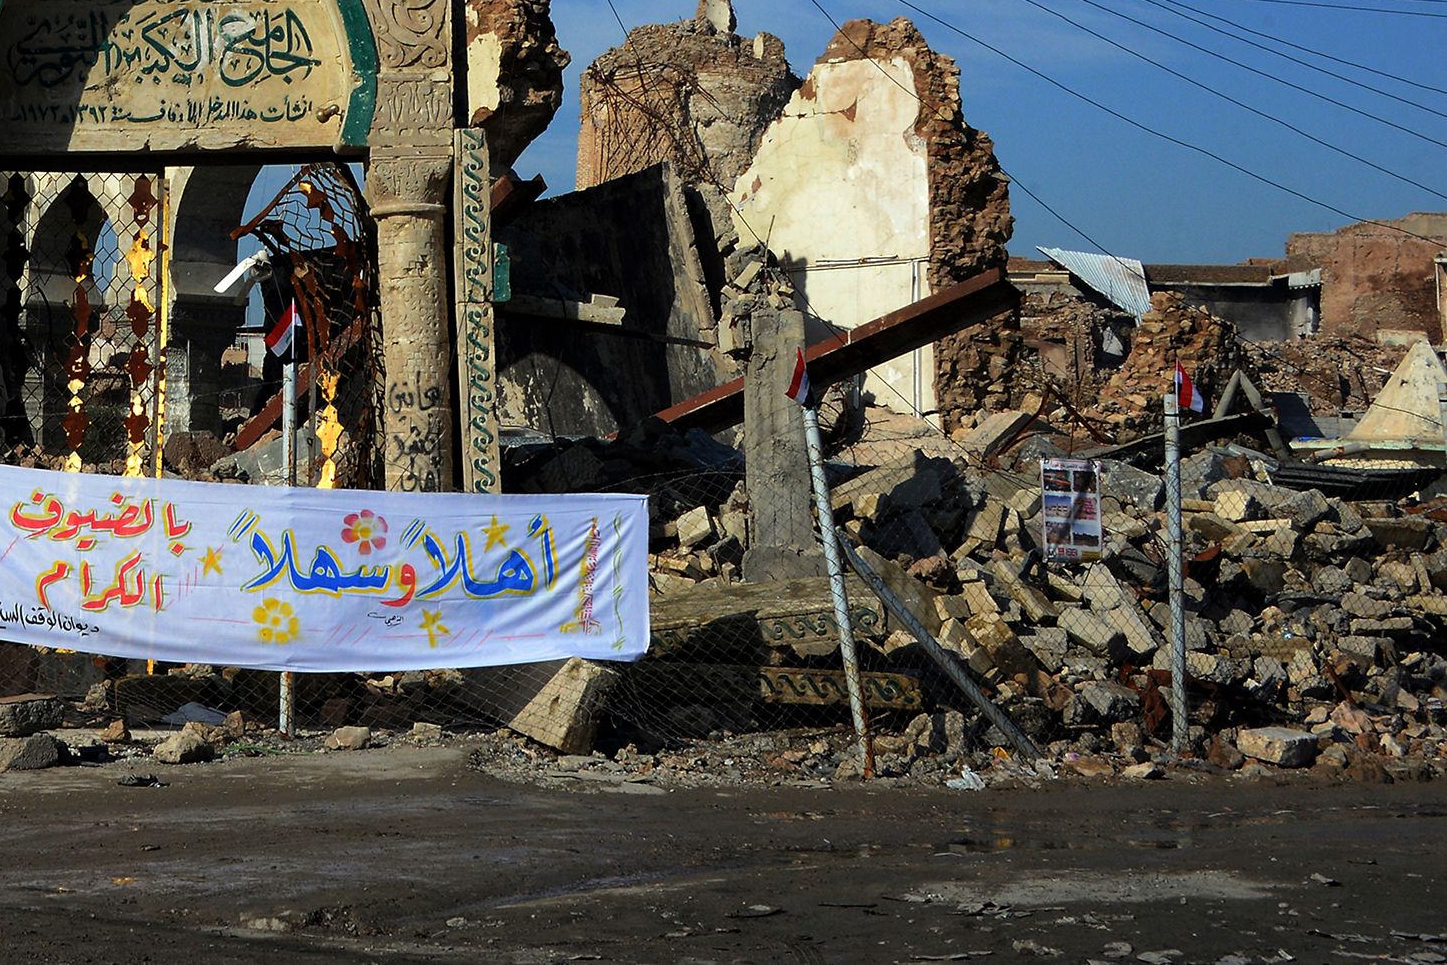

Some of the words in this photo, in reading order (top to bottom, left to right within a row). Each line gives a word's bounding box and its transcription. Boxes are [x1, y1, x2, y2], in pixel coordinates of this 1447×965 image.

[219, 7, 321, 87] الجامع
[10, 487, 196, 557] بالضيوف
[36, 549, 167, 614] الكرام
[25, 607, 63, 630] الوقف
[62, 616, 100, 636] ديوان
